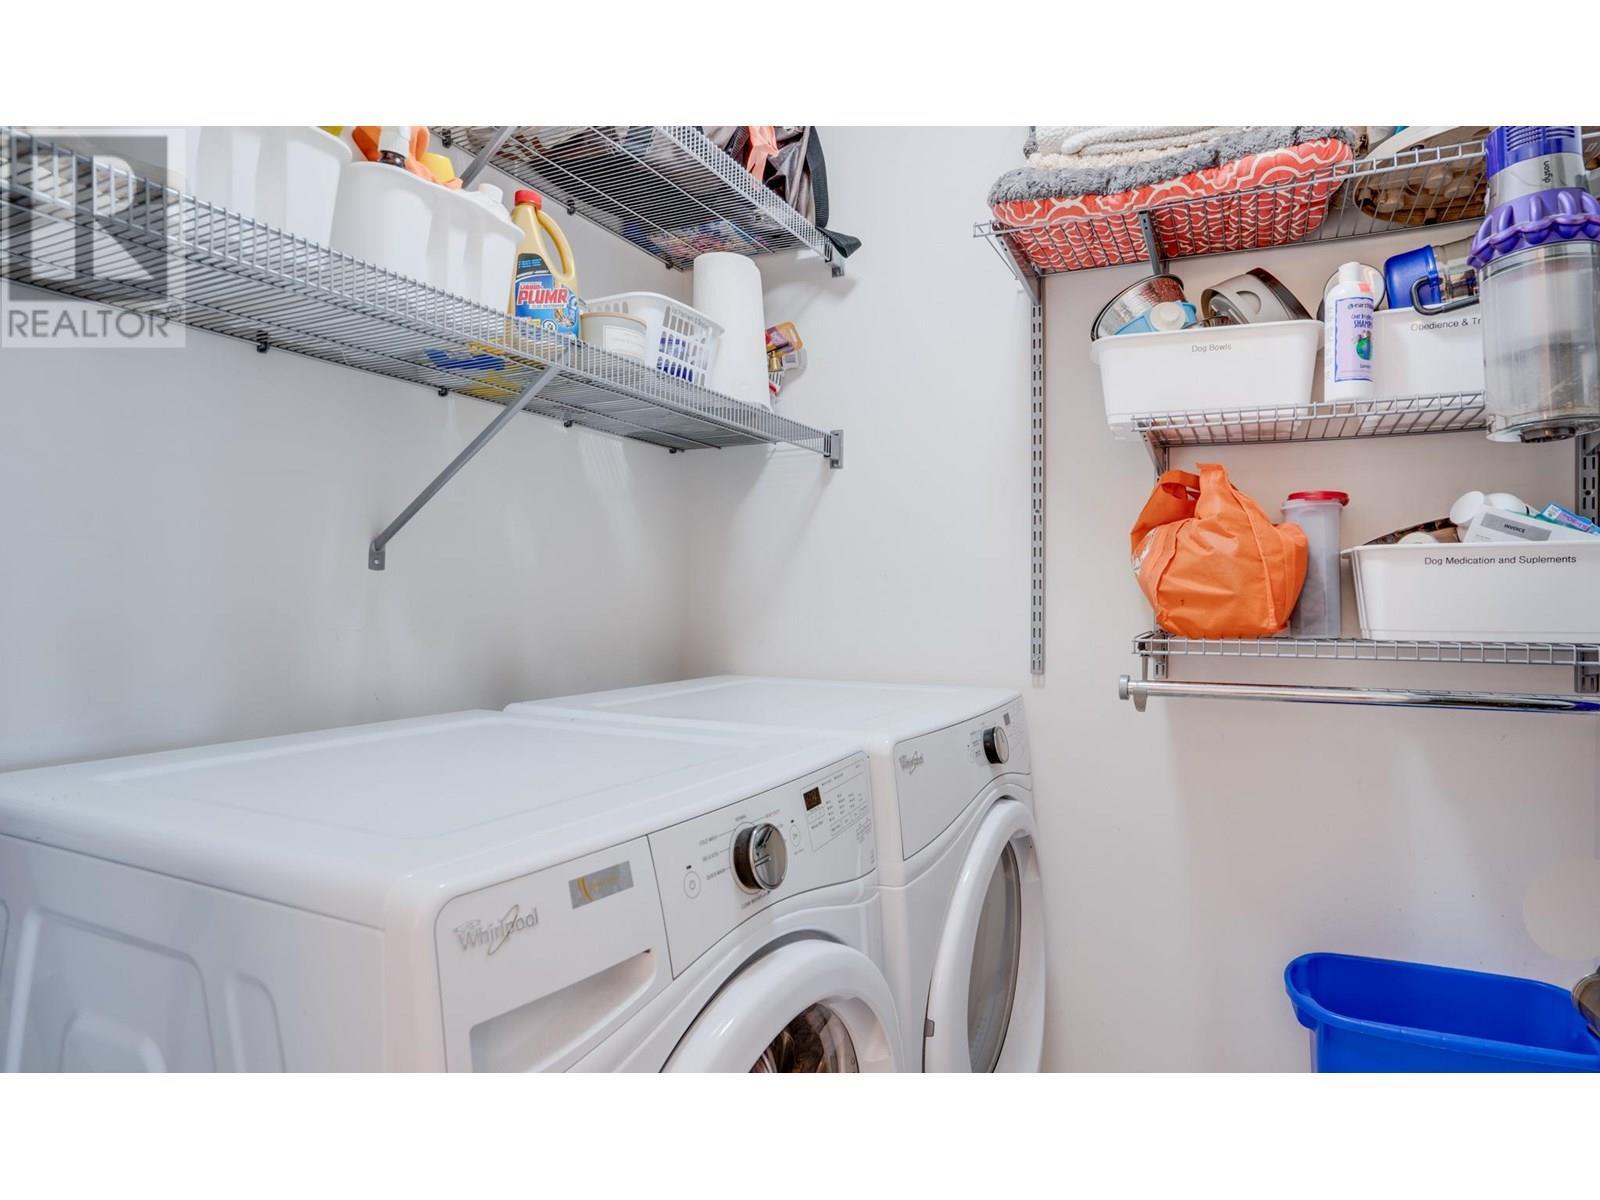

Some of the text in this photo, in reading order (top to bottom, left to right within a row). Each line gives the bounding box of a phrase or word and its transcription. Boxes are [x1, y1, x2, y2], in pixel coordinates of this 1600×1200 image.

[1542, 160, 1554, 184] dyson
[517, 289, 568, 305] PLUMR
[1410, 321, 1459, 332] Obedience
[1461, 318, 1468, 327] &
[1191, 343, 1232, 353] Dog Bowls
[1504, 523, 1526, 533] INVOICE
[1424, 555, 1577, 566] Dog Medication and Suplements
[455, 904, 539, 955] Whirlpool
